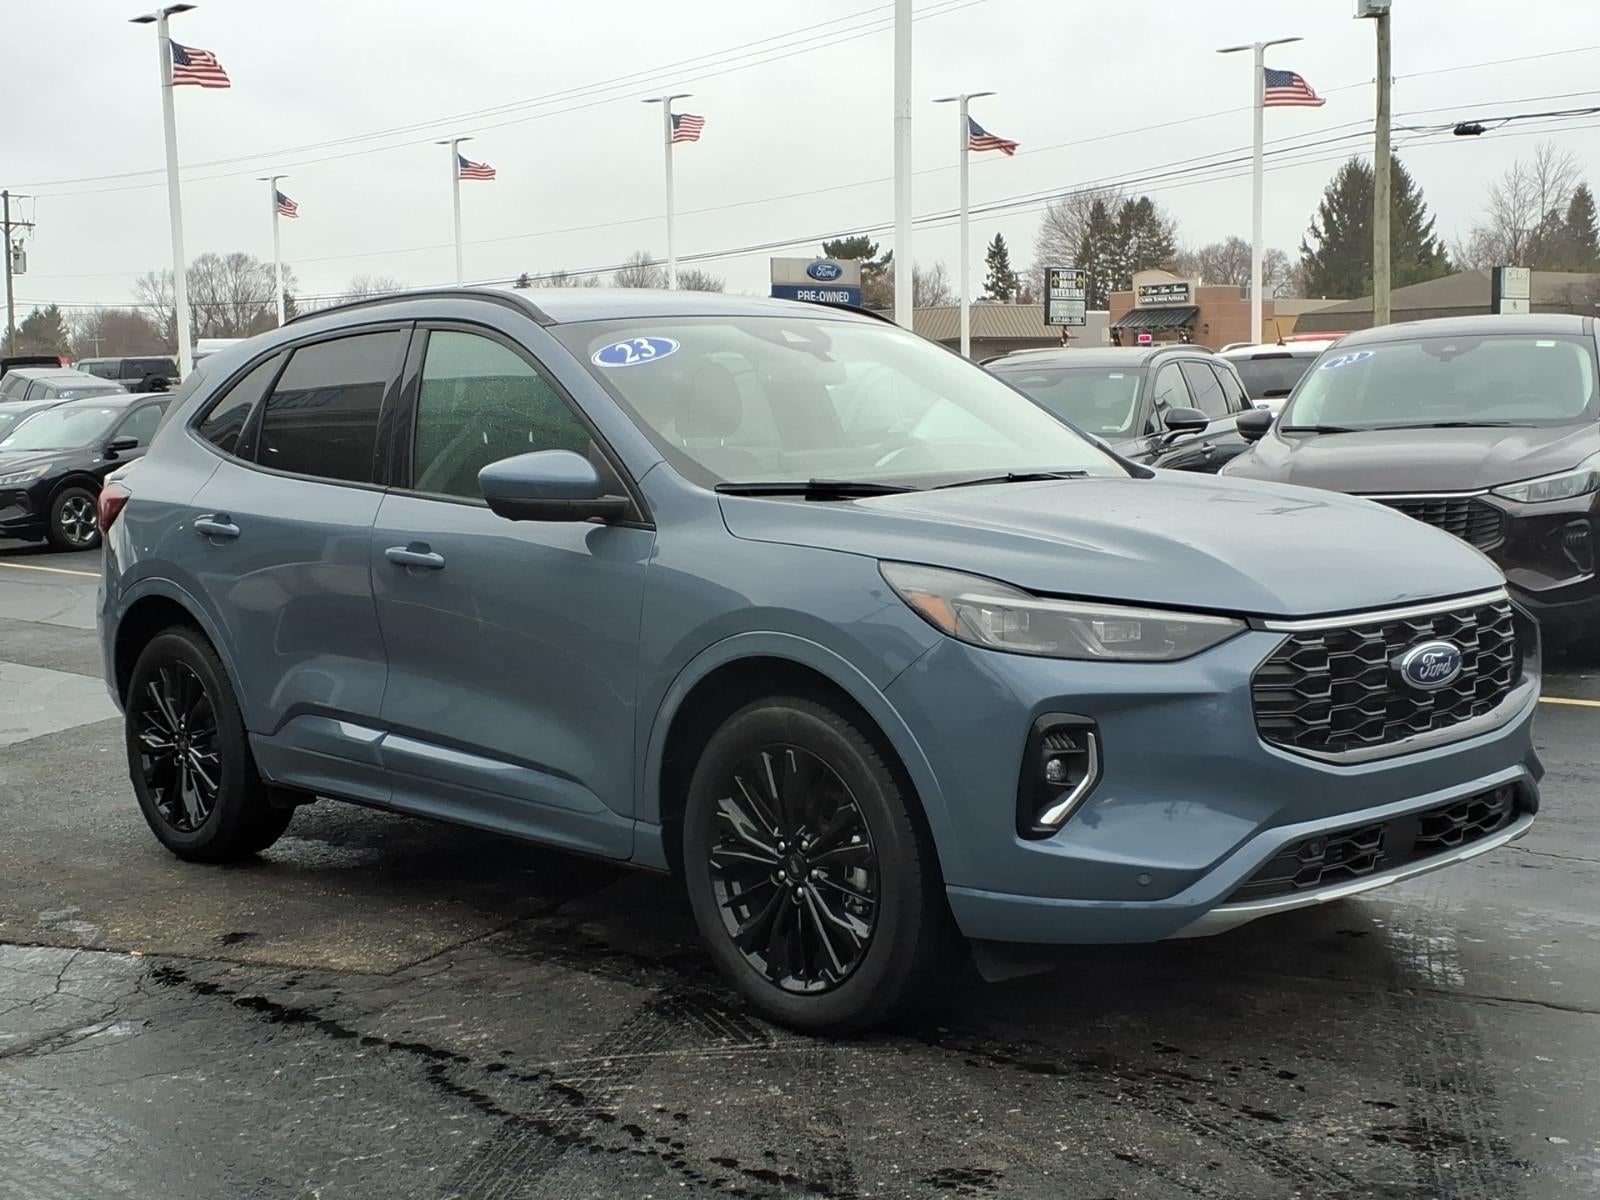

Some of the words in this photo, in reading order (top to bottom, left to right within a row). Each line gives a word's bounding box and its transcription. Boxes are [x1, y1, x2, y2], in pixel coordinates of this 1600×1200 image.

[816, 264, 837, 276] Ford
[797, 290, 849, 302] PRE-OWNED
[615, 338, 656, 363] 23
[1420, 652, 1452, 680] Ford
